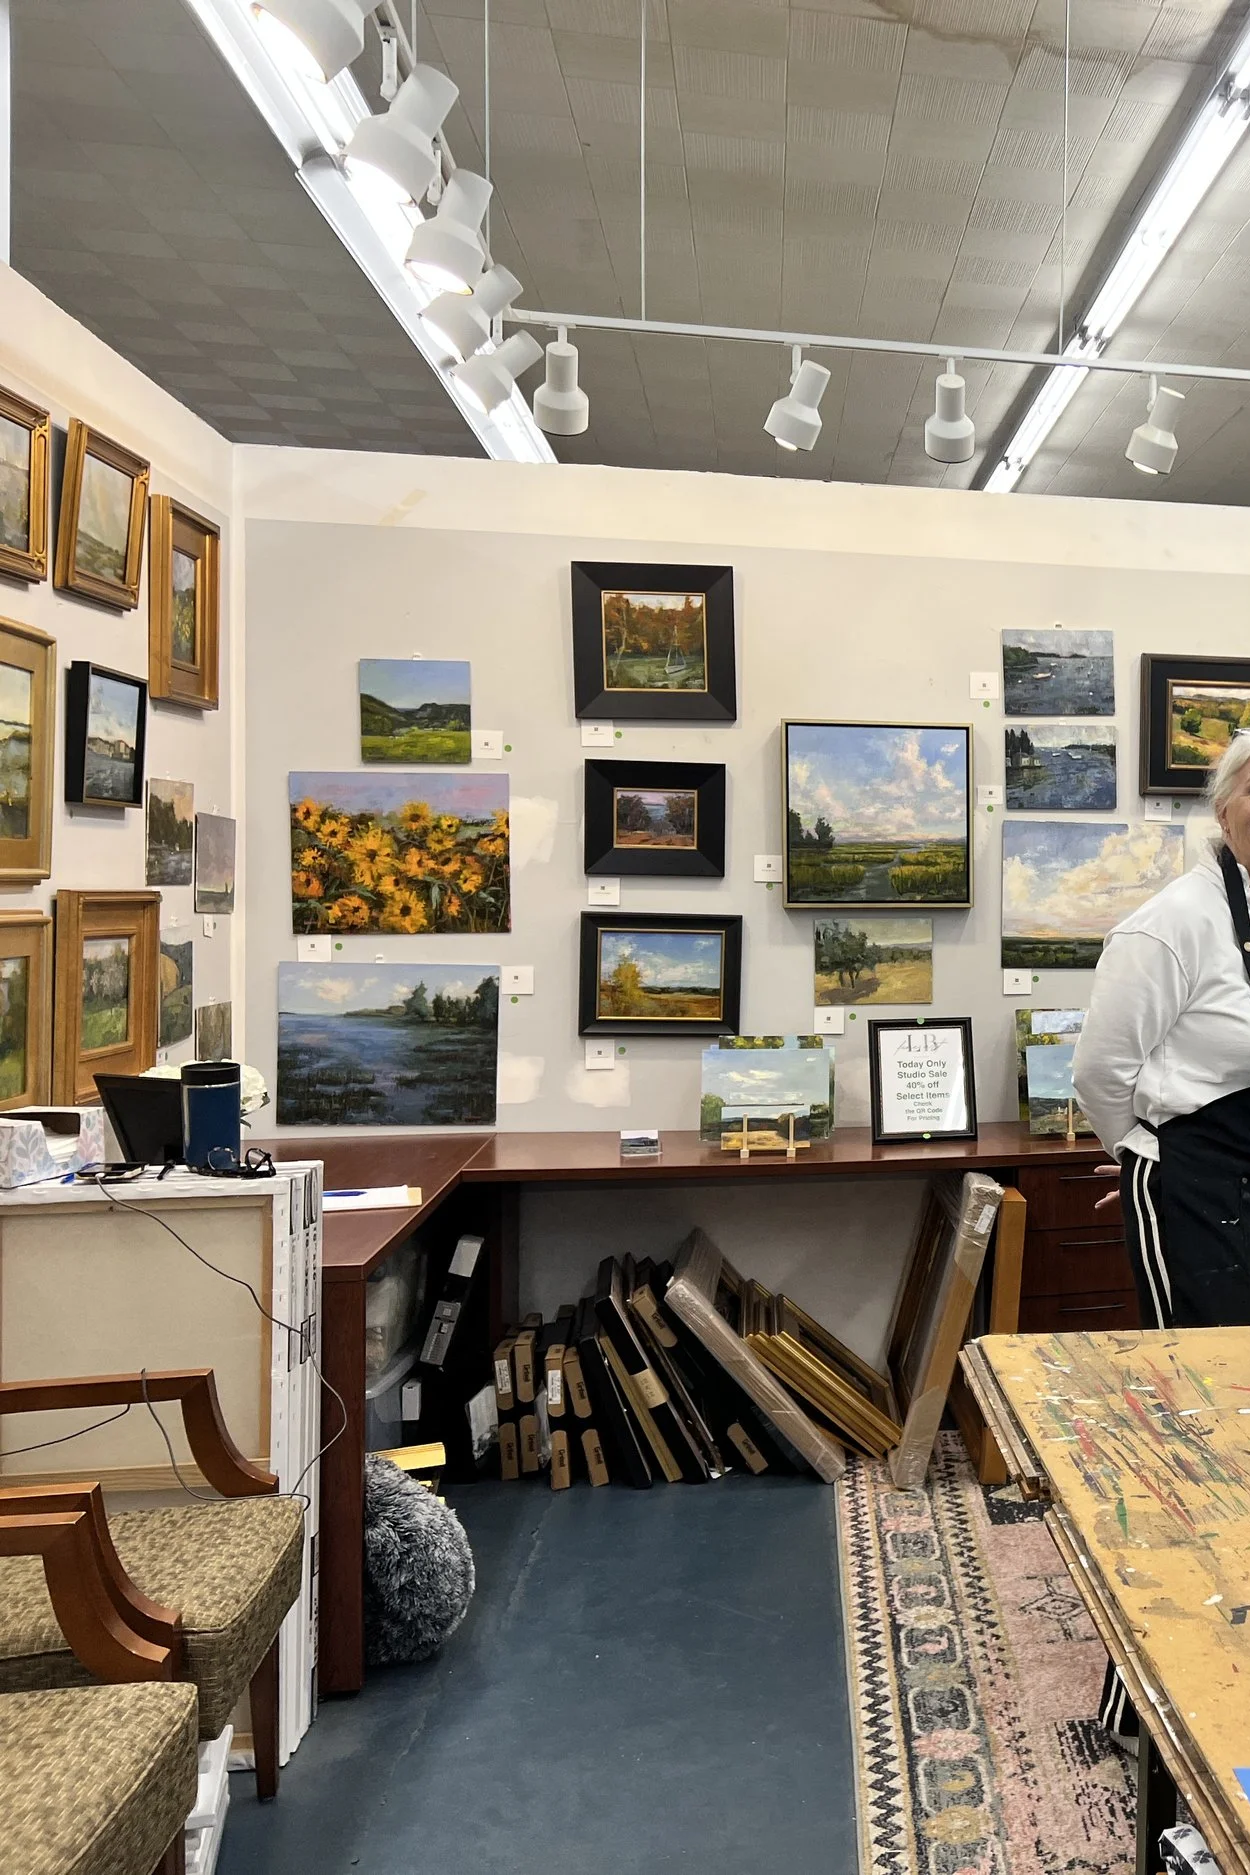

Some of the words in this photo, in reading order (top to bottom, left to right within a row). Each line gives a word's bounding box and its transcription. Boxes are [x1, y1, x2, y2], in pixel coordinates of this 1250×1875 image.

[897, 1060, 923, 1069] Today
[926, 1060, 947, 1069] Only
[897, 1071, 926, 1079] Studio
[928, 1070, 948, 1078] Sale
[906, 1081, 925, 1089] 40%
[896, 1092, 924, 1100] Select
